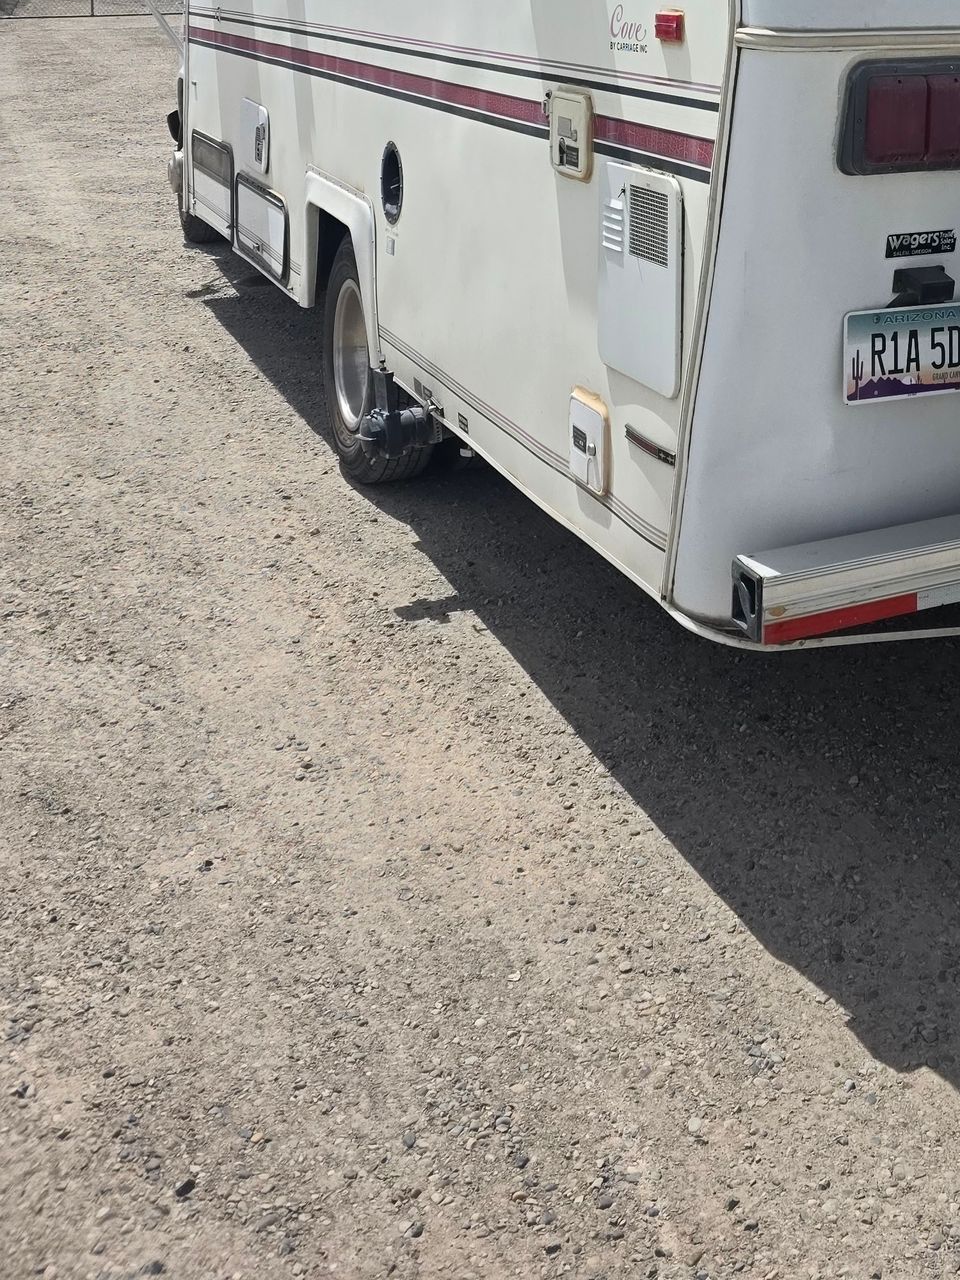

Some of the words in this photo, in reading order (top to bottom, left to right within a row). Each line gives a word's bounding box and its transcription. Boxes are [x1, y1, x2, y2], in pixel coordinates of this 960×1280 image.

[610, 3, 647, 42] Cove
[610, 41, 616, 50] BY
[617, 42, 639, 53] CARRIAGE
[640, 44, 648, 54] INC
[888, 231, 940, 251] Wagers
[884, 310, 957, 325] ARIZONA
[871, 329, 920, 377] R1A
[932, 372, 949, 381] GRAND
